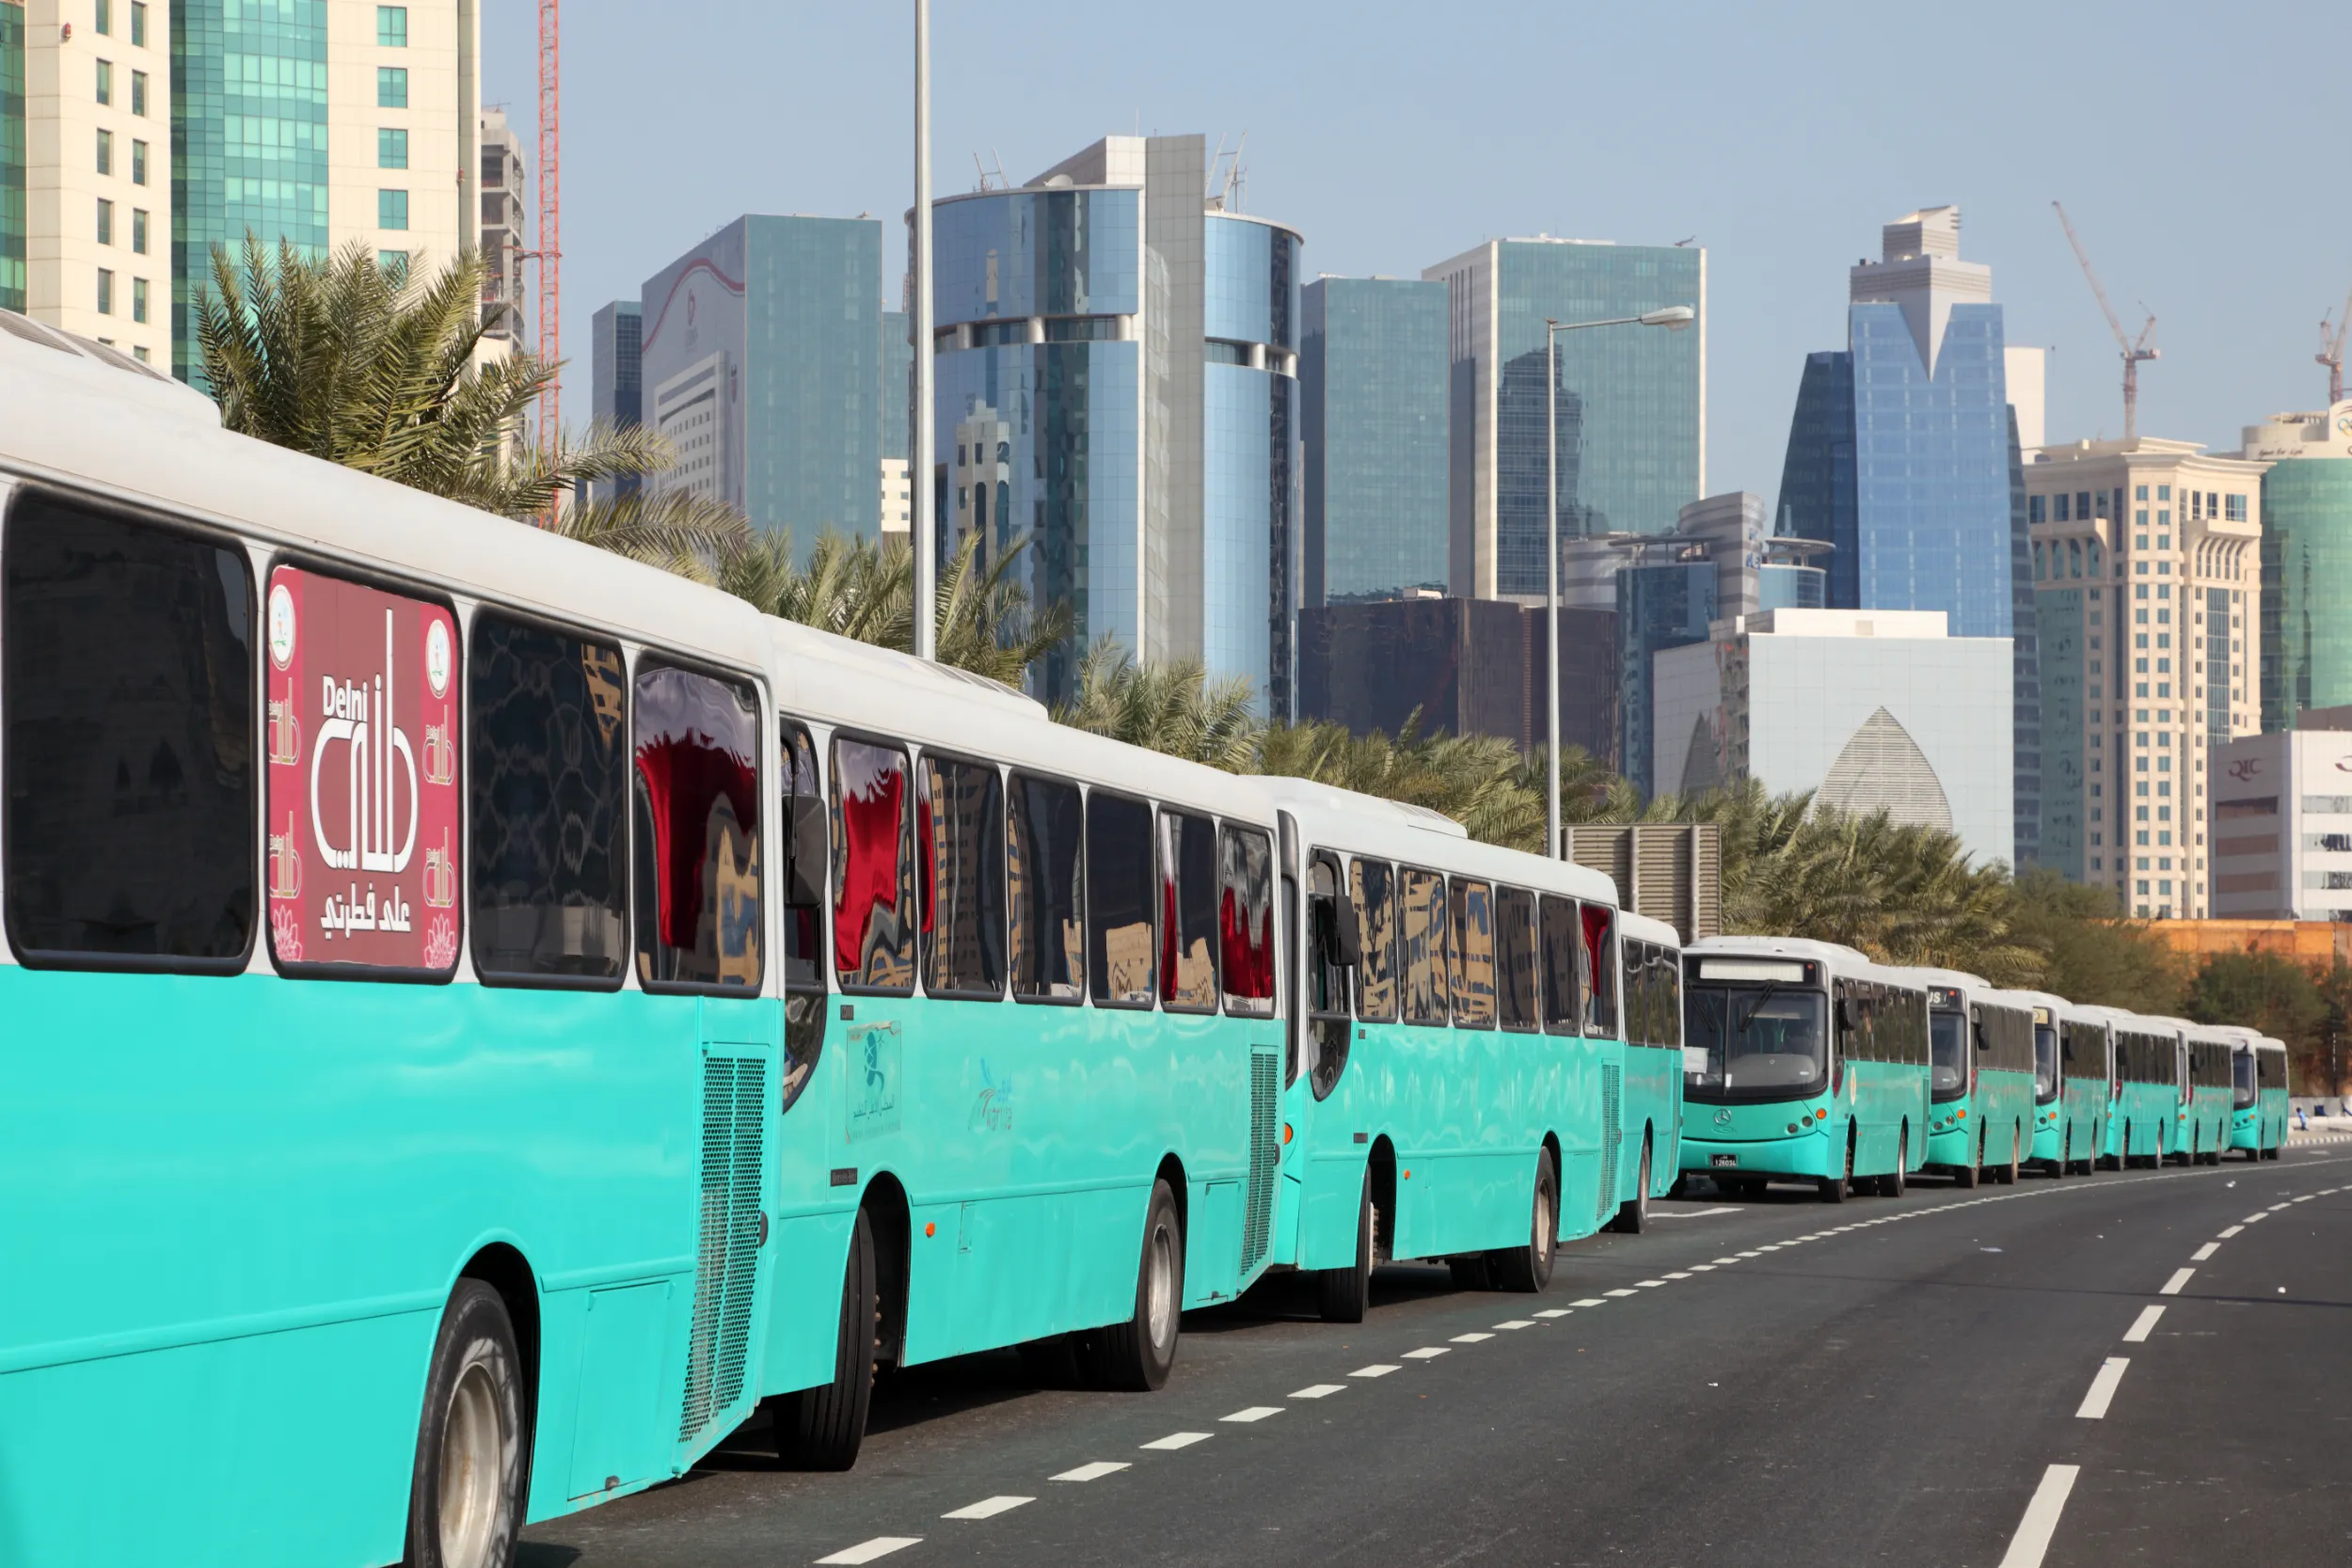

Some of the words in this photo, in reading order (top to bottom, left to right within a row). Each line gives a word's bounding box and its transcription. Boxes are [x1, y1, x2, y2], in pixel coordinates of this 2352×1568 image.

[323, 674, 368, 722] Delni
[2228, 757, 2264, 783] QIC
[320, 882, 376, 941] فطرتي
[378, 885, 411, 932] على
